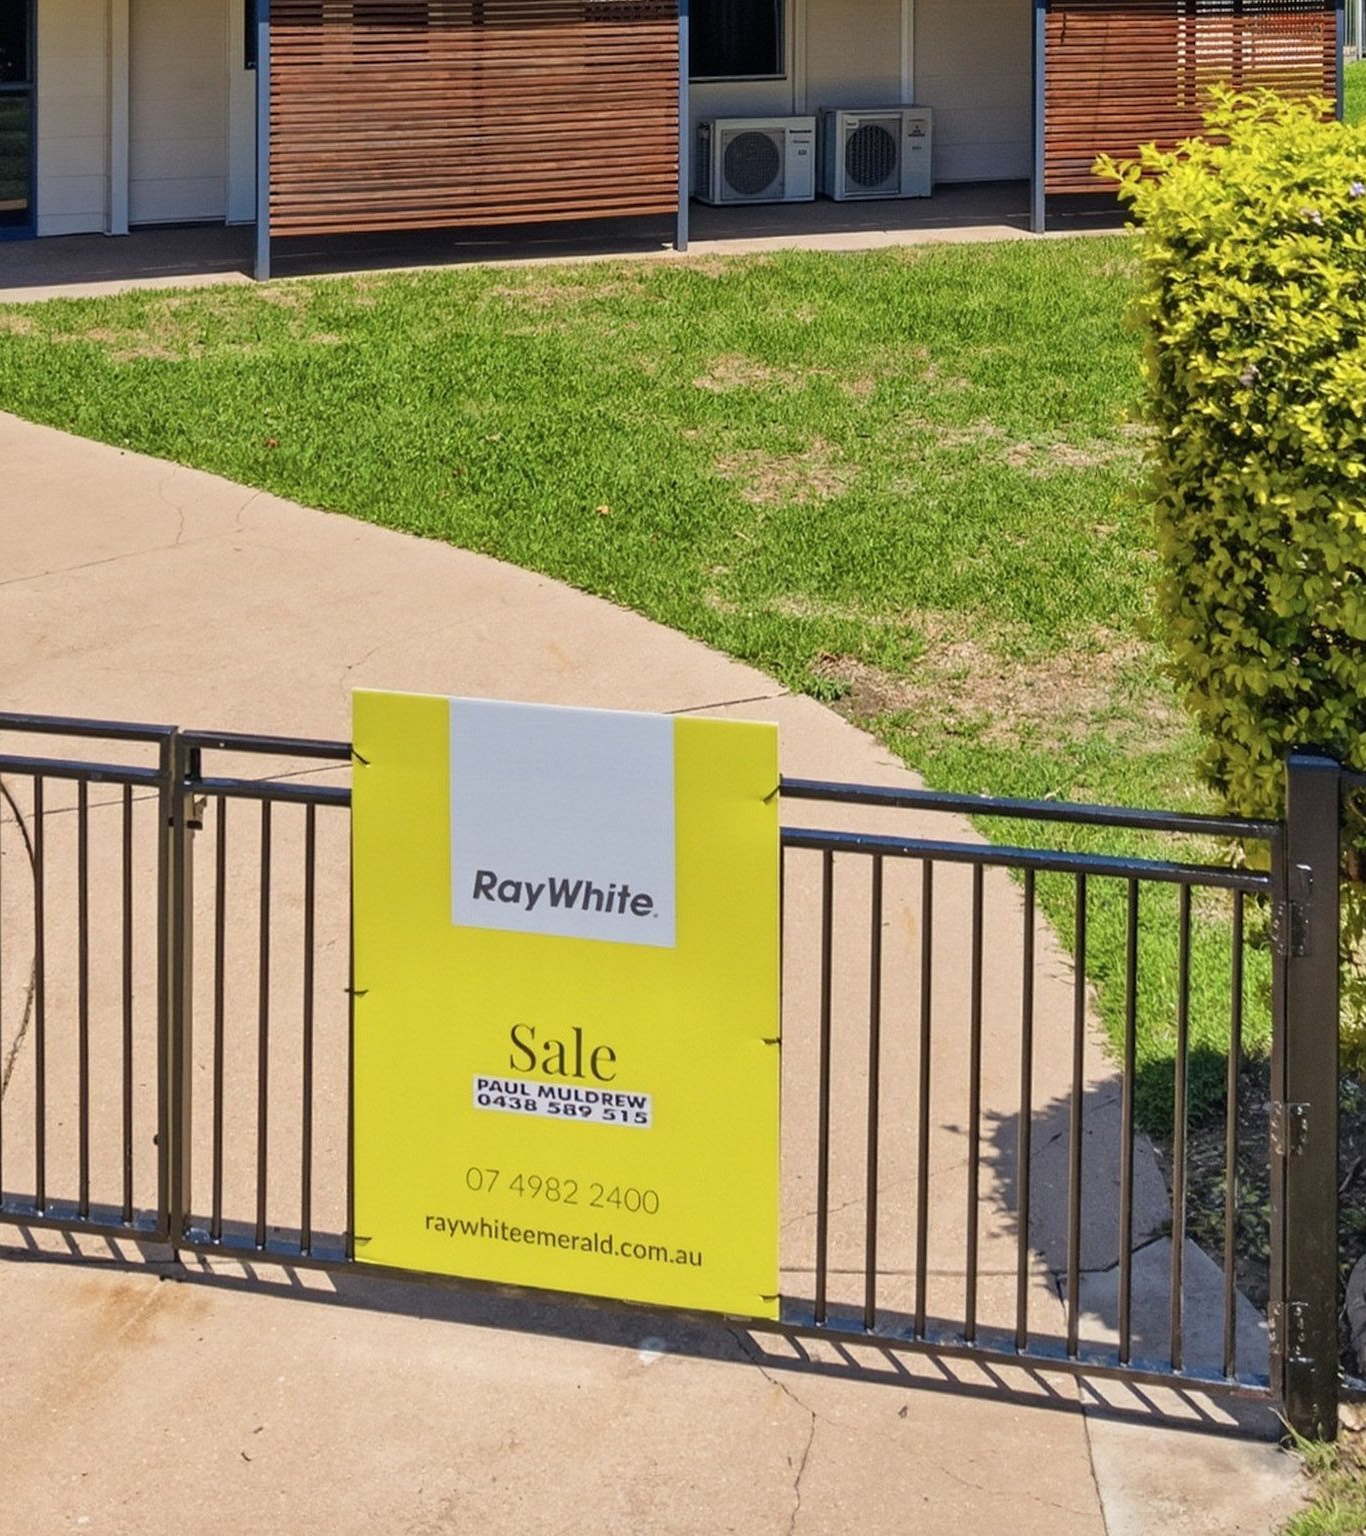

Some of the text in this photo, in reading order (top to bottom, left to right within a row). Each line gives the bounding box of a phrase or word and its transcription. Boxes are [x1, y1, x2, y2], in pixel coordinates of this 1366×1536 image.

[509, 1022, 618, 1083] Sale
[477, 1078, 647, 1109] PAUL MULDREW
[477, 1093, 648, 1125] 0438 589 515
[465, 1166, 660, 1215] 07 4982 2400
[425, 1214, 703, 1267] raywhiteemerald.com.au
